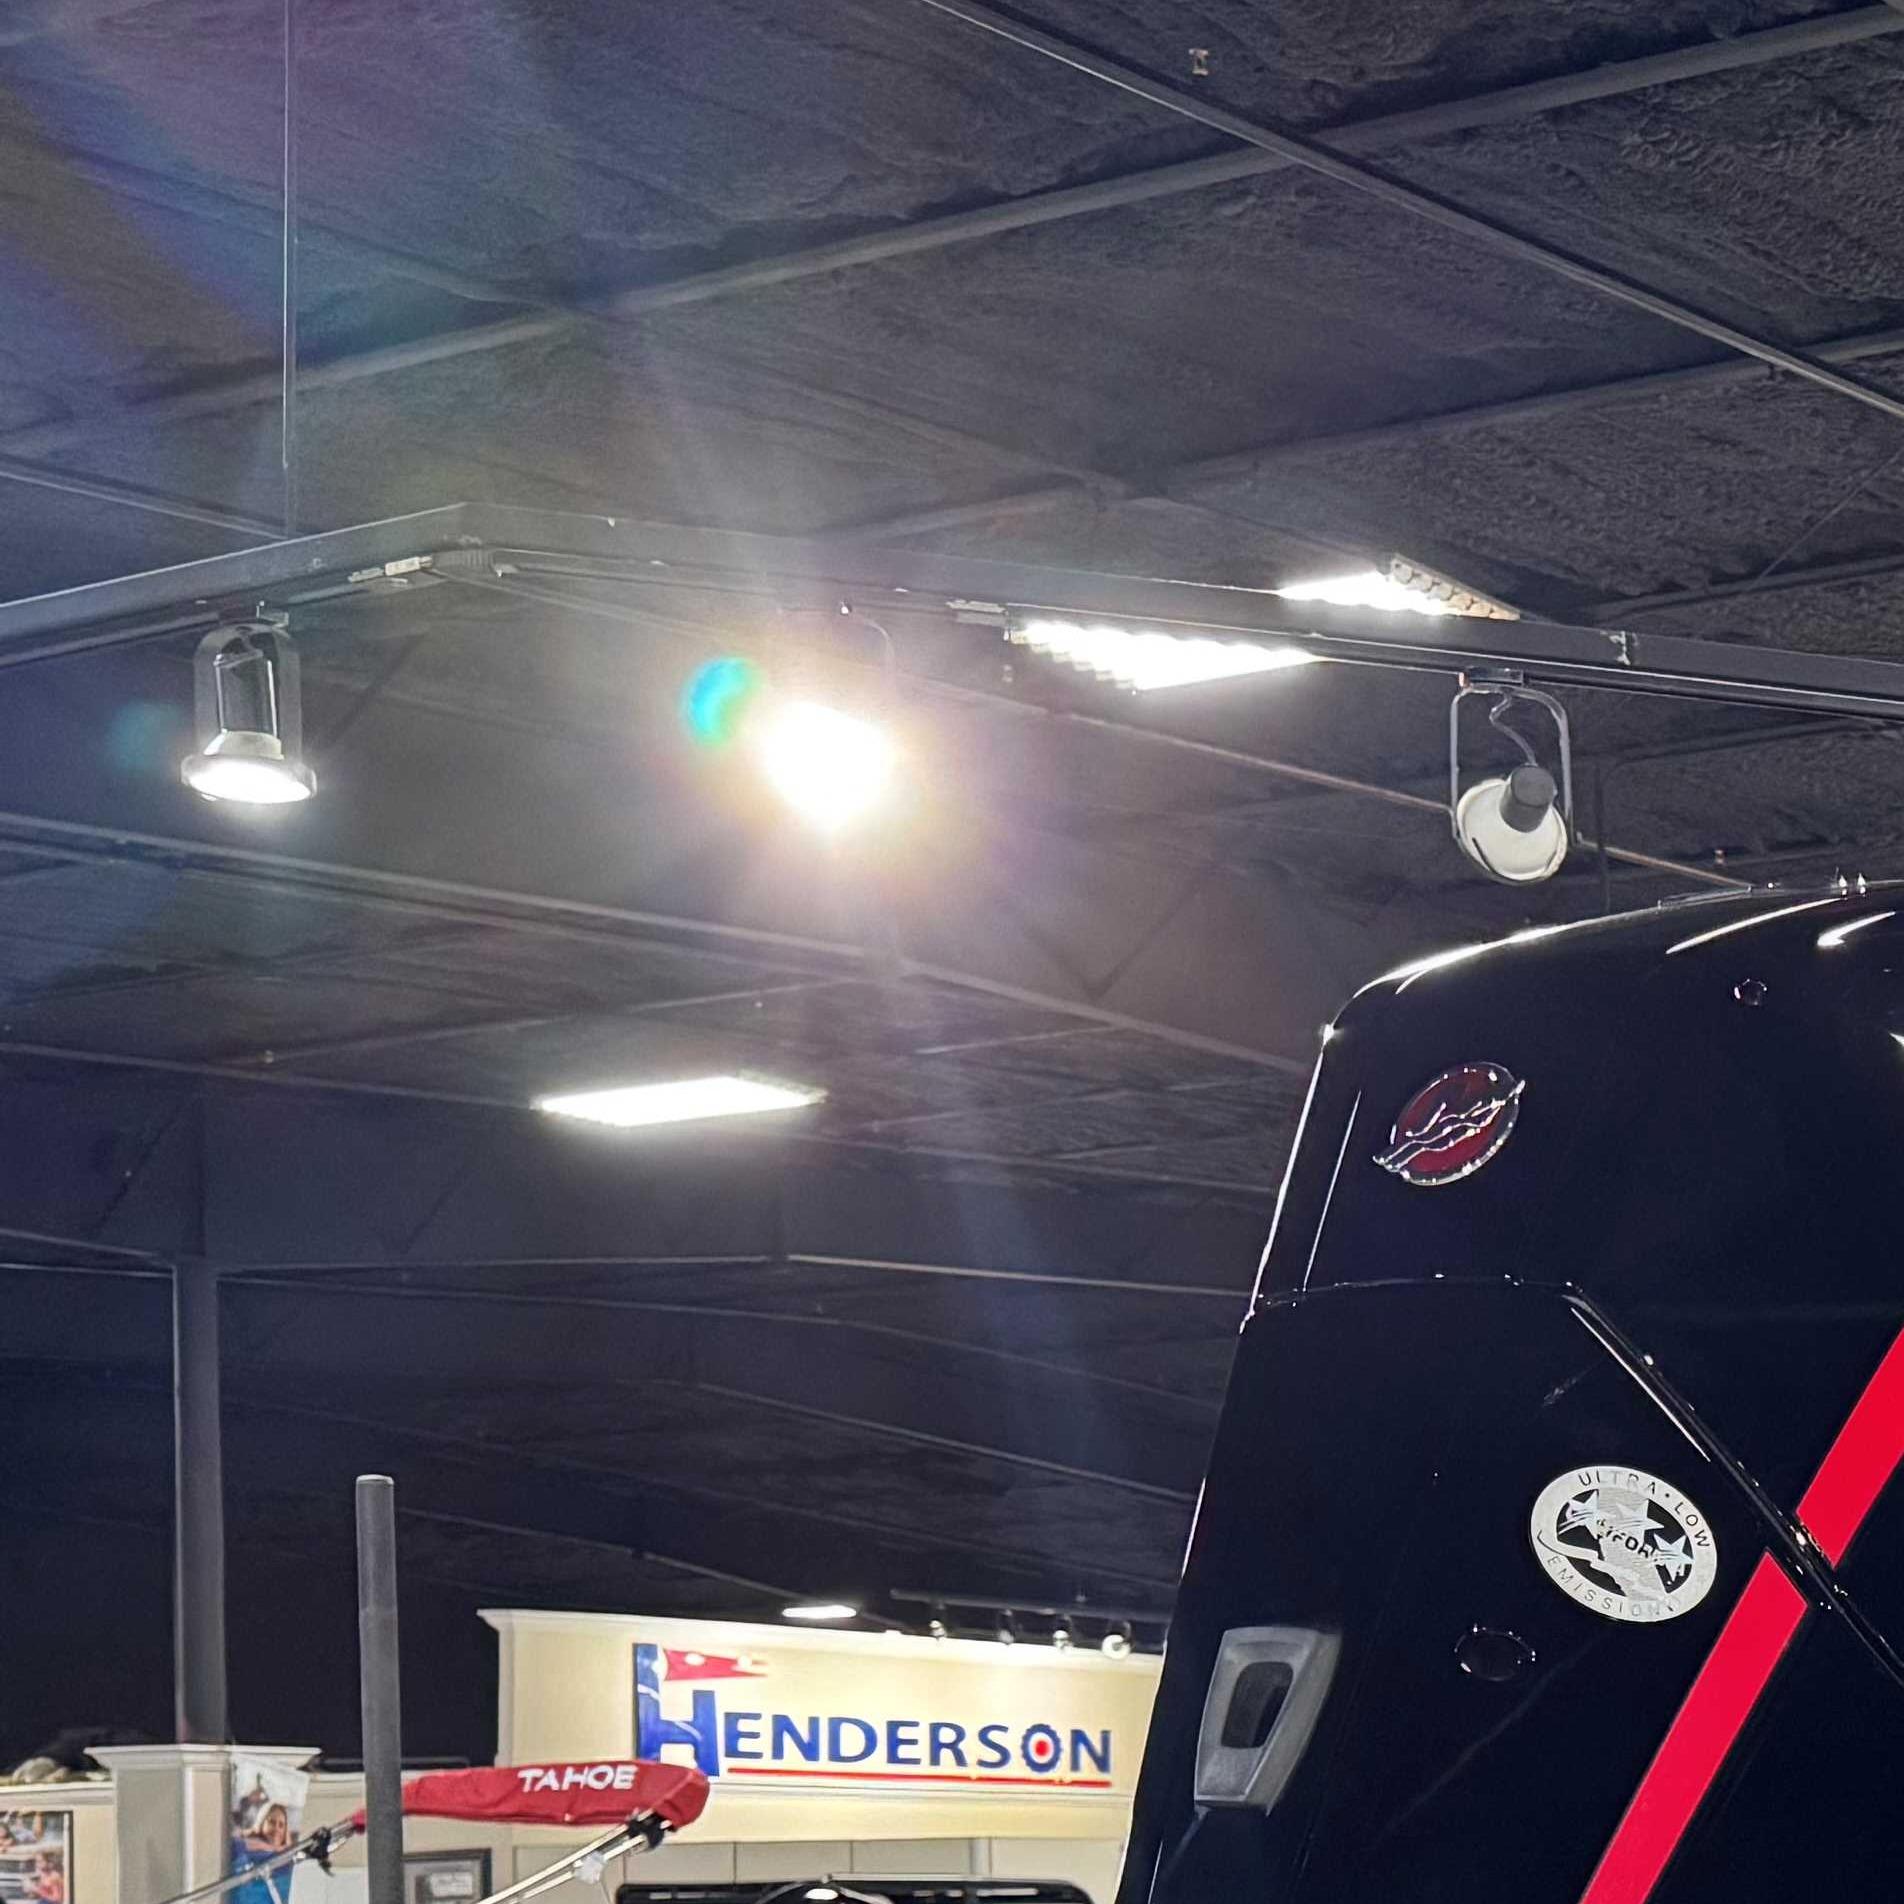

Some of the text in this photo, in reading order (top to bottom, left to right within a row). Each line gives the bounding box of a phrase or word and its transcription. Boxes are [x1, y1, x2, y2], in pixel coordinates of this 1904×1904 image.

[1578, 1470, 1657, 1495] ULTRA
[1674, 1502, 1710, 1548] LOW
[632, 1643, 1112, 1776] HENDERSON
[517, 1764, 638, 1793] TAHOE
